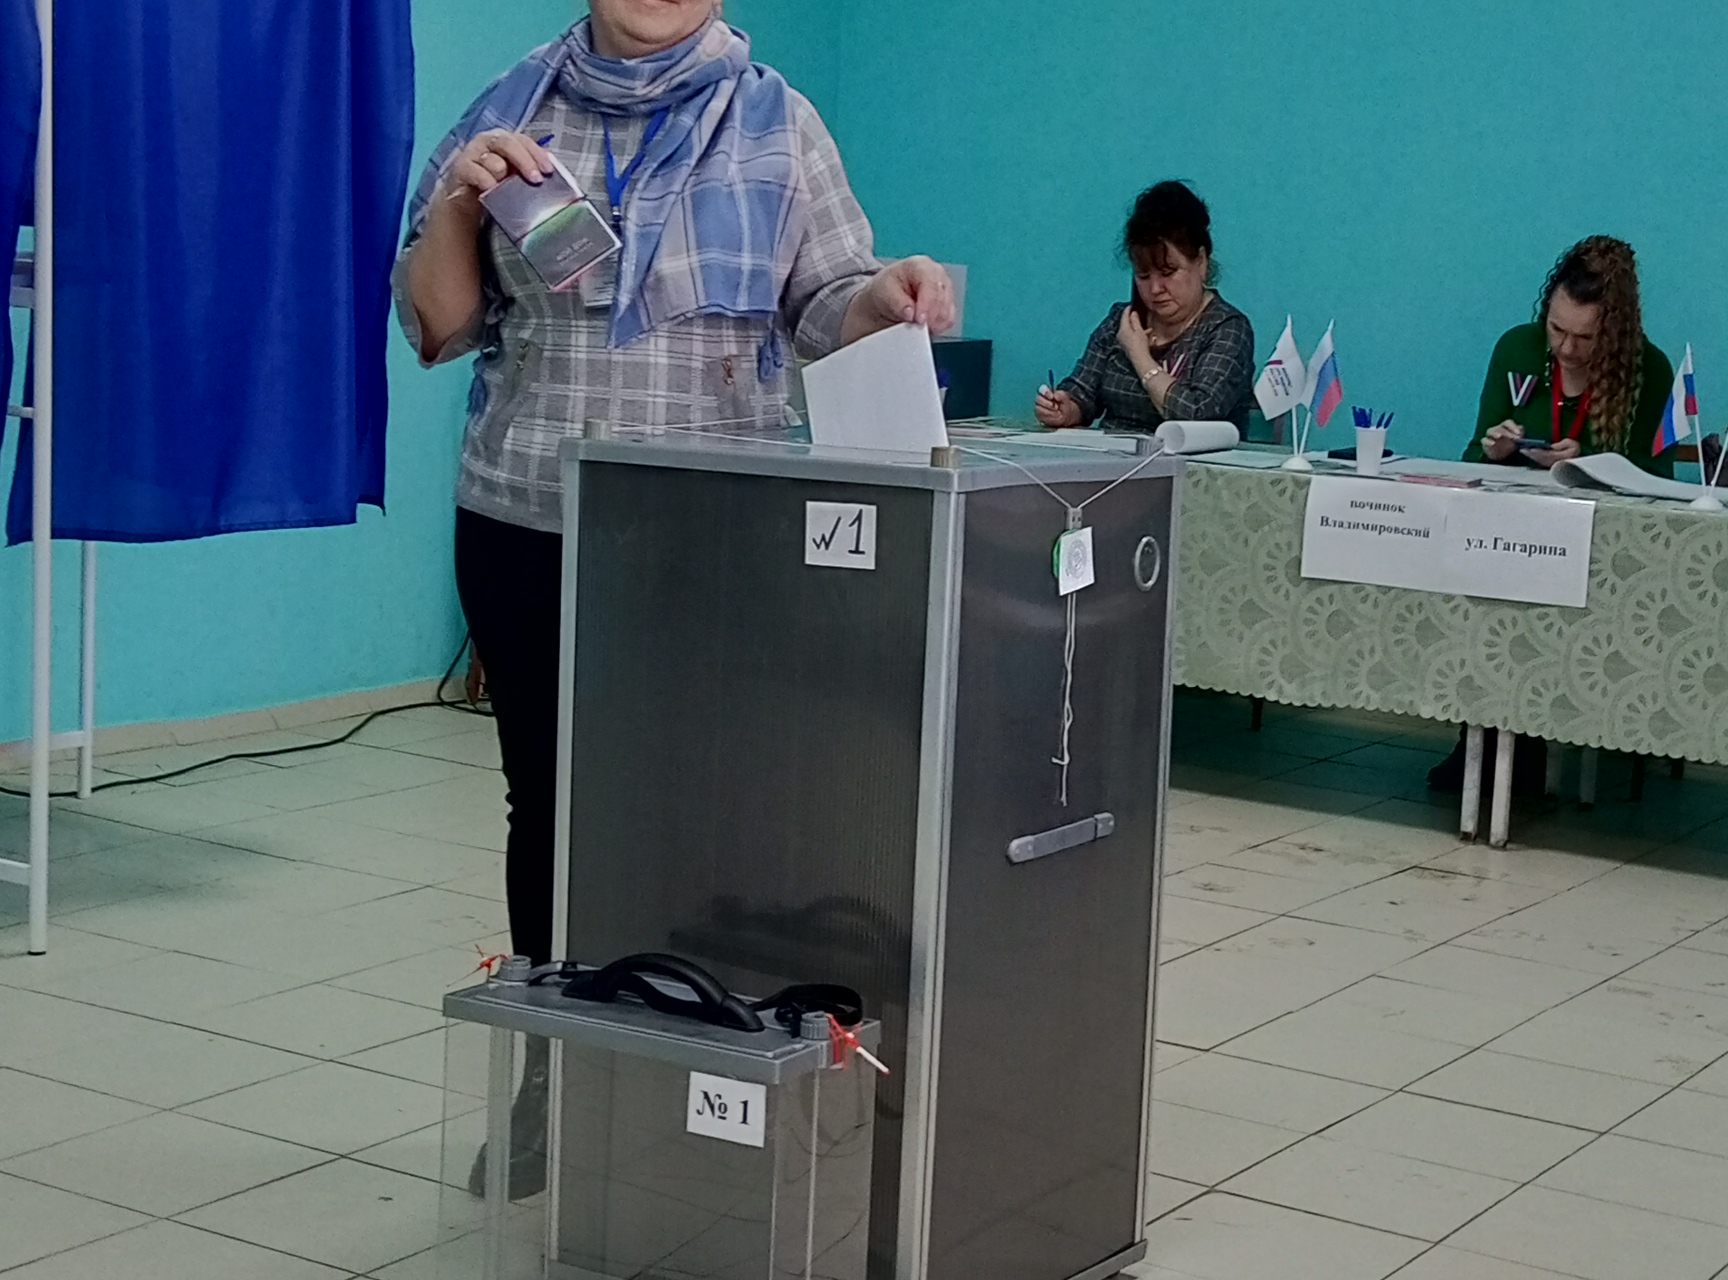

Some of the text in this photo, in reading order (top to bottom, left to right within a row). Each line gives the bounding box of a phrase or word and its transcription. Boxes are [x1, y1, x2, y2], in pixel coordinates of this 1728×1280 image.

[1350, 500, 1406, 514] починок
[1319, 515, 1431, 539] Владимировский
[1464, 536, 1567, 558] ул. Гагарина
[696, 1089, 750, 1126] № 1
